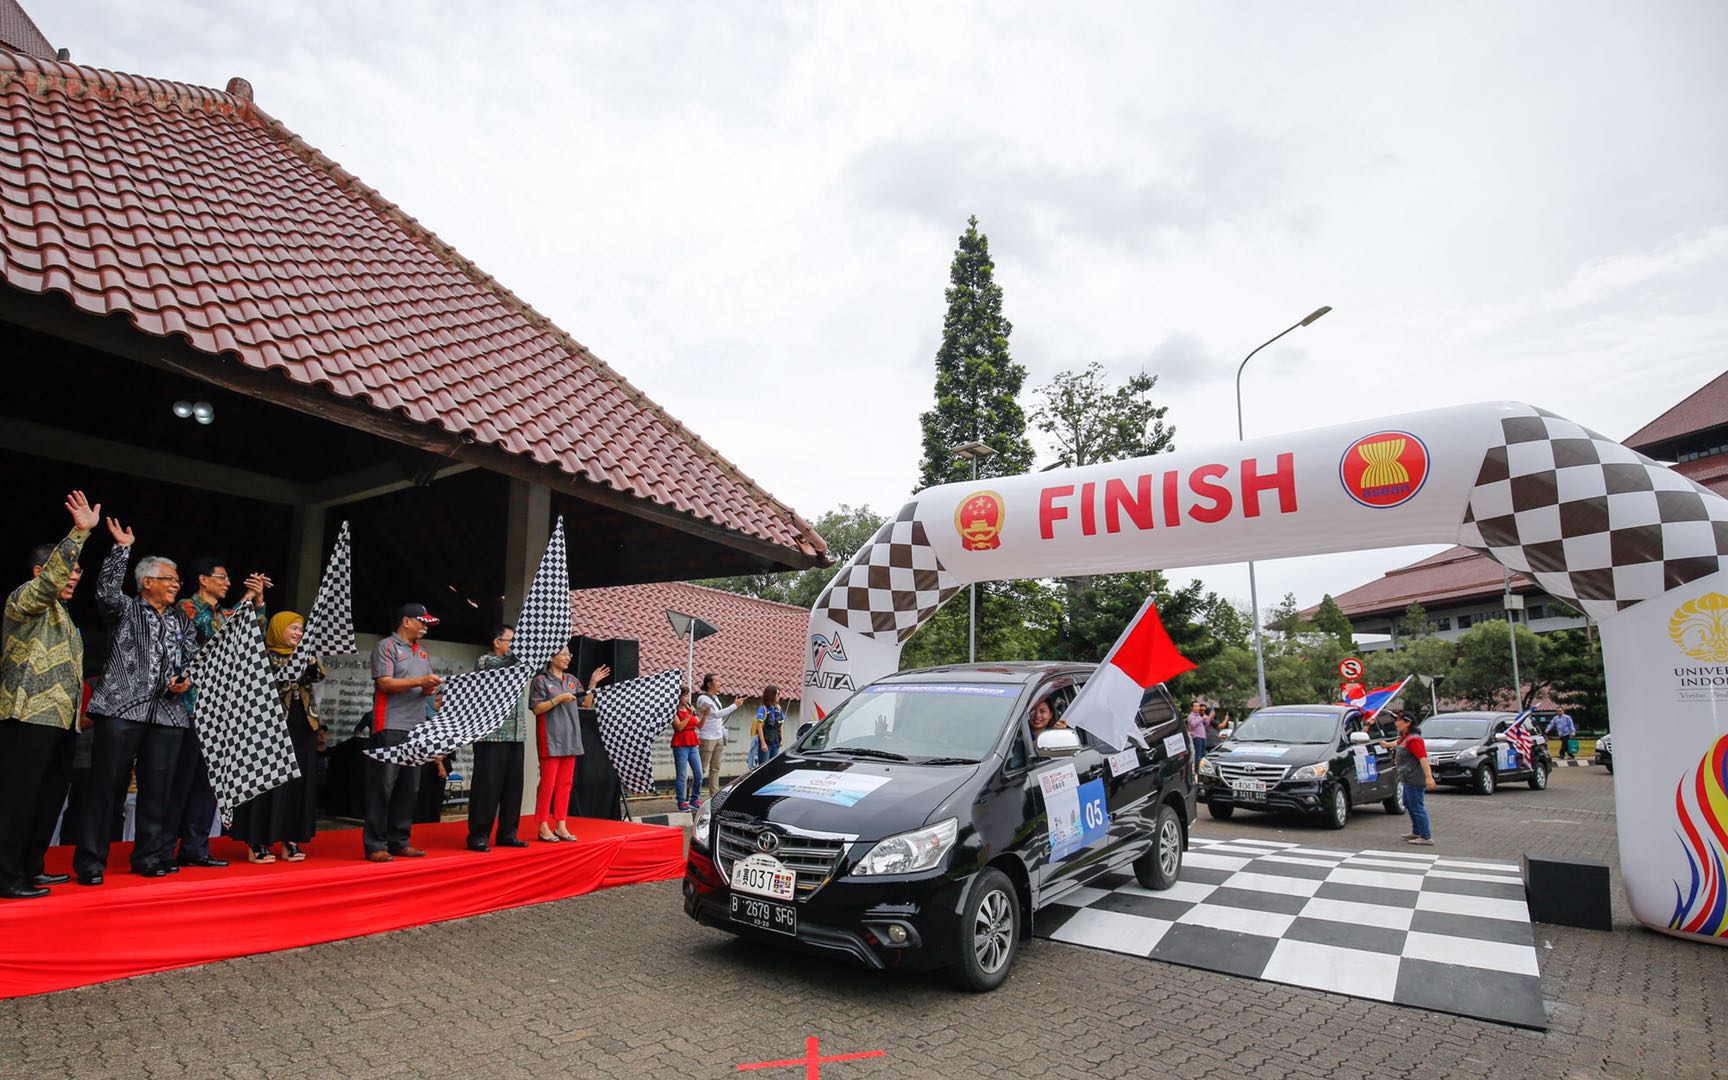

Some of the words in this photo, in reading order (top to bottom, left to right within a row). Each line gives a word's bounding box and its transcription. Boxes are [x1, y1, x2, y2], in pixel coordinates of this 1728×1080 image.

[1039, 452, 1297, 539] FINISH
[1362, 484, 1409, 498] asean
[804, 670, 856, 691] CAITA
[1681, 677, 1728, 686] INDO
[1086, 799, 1103, 829] 05
[750, 869, 774, 891] 037
[732, 897, 738, 912] B
[746, 901, 770, 920] 2679
[775, 907, 794, 926] SFG
